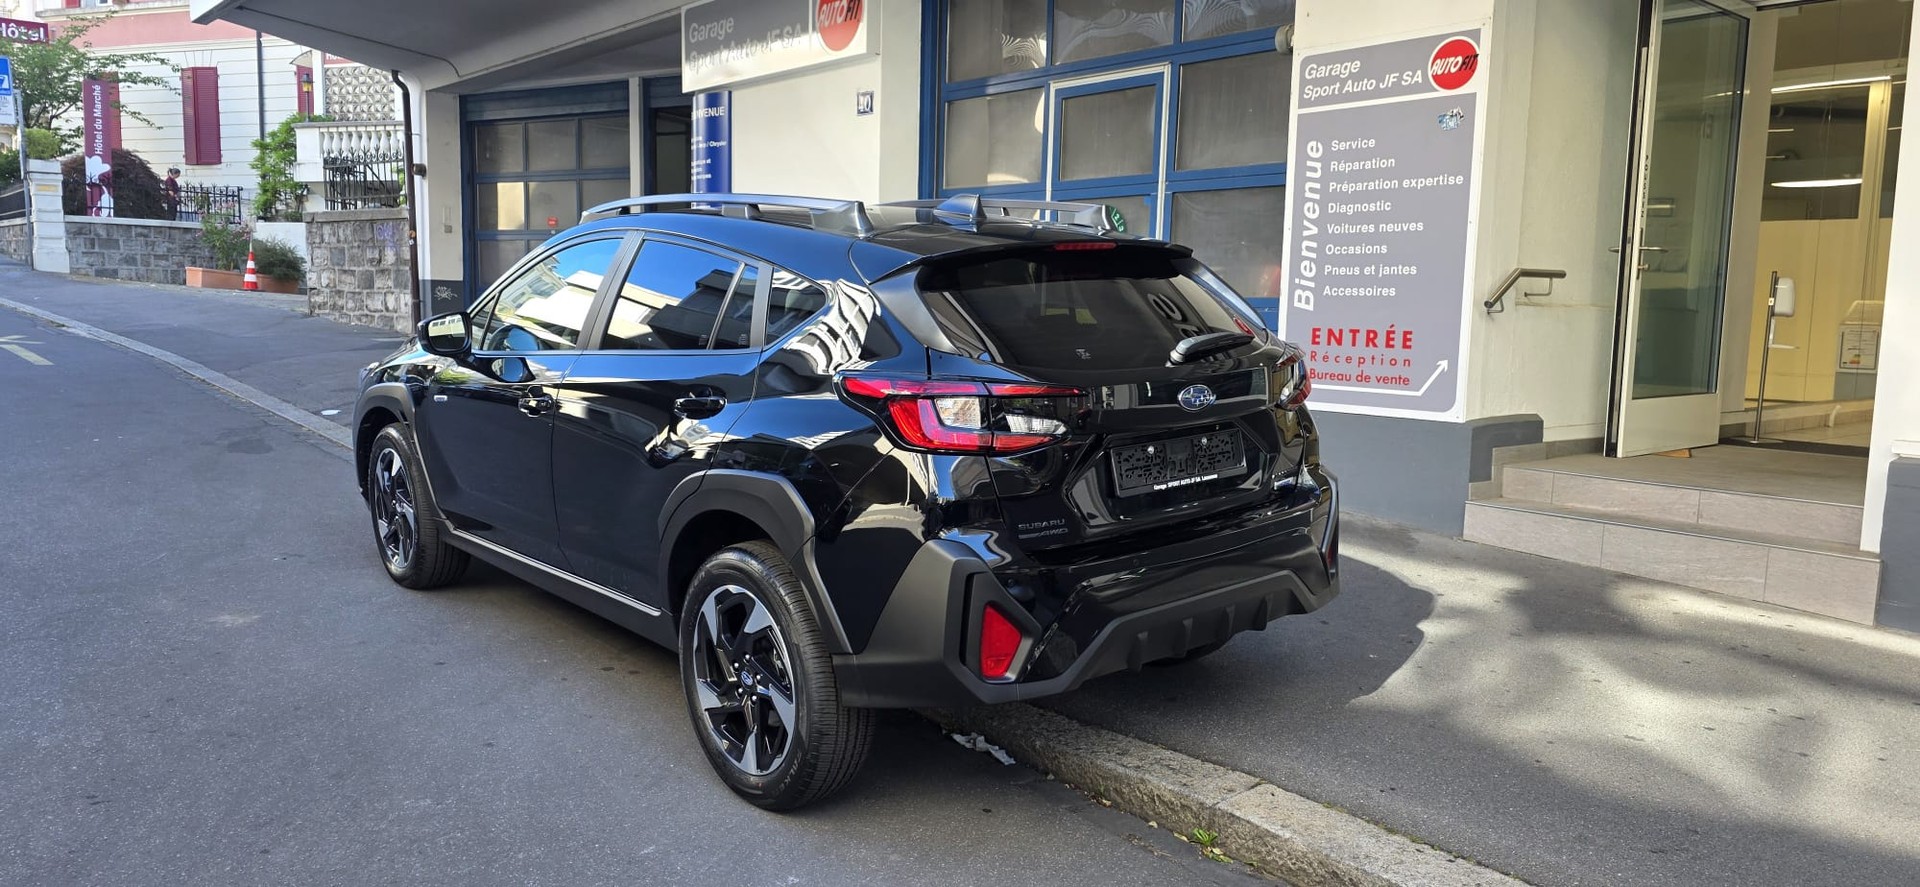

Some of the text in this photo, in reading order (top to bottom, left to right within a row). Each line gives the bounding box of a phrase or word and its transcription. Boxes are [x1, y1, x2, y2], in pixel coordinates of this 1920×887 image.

[688, 17, 734, 43] Garage
[1305, 59, 1361, 80] Garage
[1431, 53, 1479, 76] AUTOFIT
[1303, 69, 1423, 101] Sport Auto JF SA
[92, 84, 103, 154] Hôtel du Marché
[1331, 138, 1376, 151] Service
[1330, 157, 1396, 173] Réparation
[1329, 174, 1464, 194] Préparation expertise
[1328, 200, 1392, 215] Diagnostic
[1294, 140, 1323, 311] Bienvenue
[1327, 221, 1424, 234] Voitures neuves
[1325, 243, 1388, 255] Occasions
[1324, 264, 1418, 277] Pneus et jantes
[1323, 285, 1396, 297] Accessoires
[1311, 324, 1413, 350] ENTRÉE
[1310, 351, 1411, 368] Réception
[1309, 368, 1411, 386] Bureau de vente
[1018, 518, 1065, 530] SUBARU
